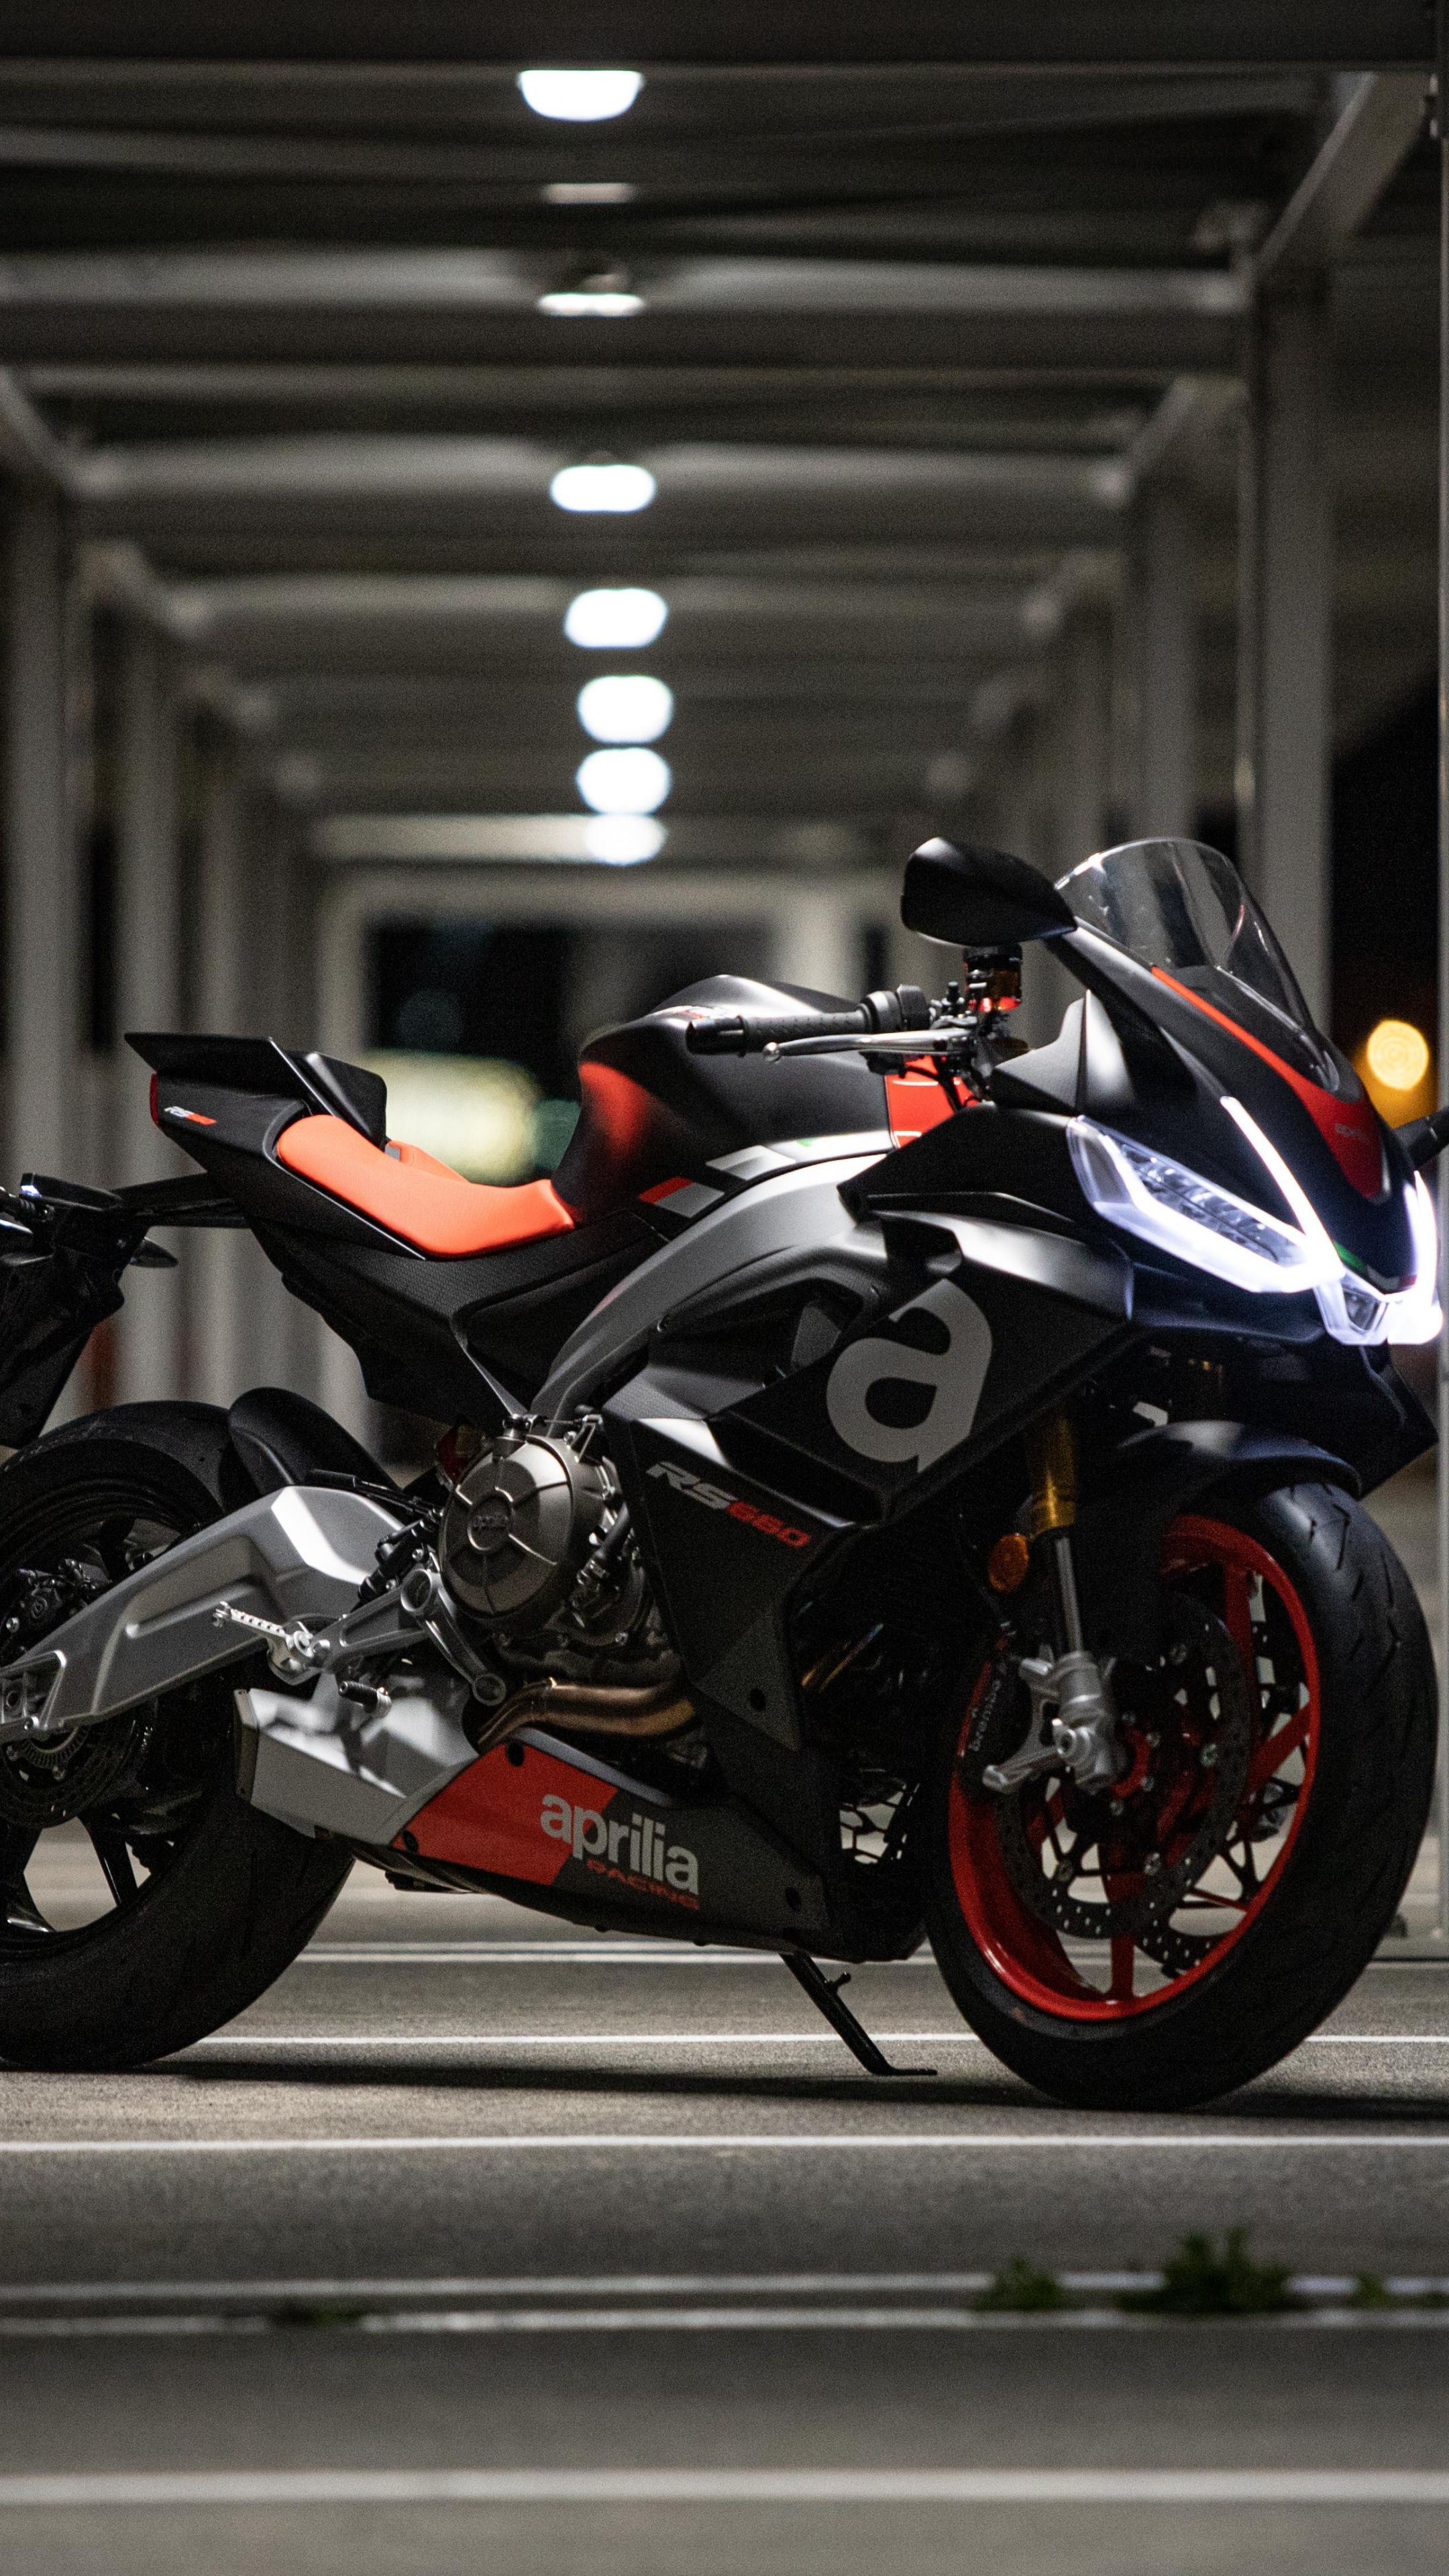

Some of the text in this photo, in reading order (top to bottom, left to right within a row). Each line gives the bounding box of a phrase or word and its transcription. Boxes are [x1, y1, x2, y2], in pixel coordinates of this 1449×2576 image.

[826, 1278, 993, 1473] a
[541, 1794, 698, 1895] aprilia
[586, 1859, 700, 1910] RACING
